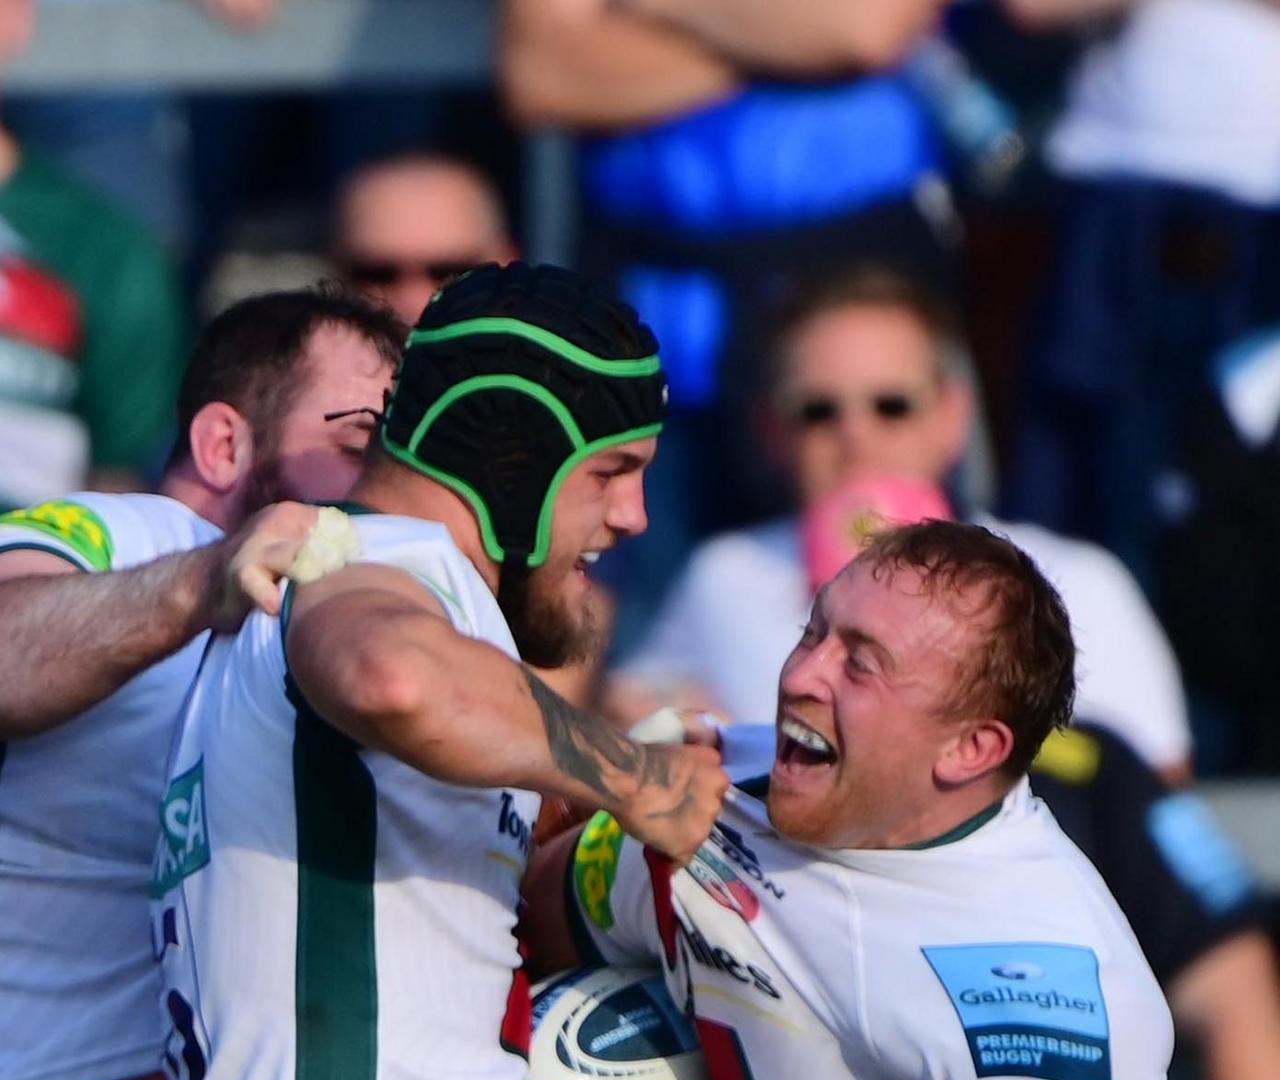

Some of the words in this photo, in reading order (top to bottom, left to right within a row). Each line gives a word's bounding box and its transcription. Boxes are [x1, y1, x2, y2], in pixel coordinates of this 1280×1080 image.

[959, 986, 1097, 1014] Gallagher
[975, 1033, 1104, 1064] PREMIERSHIP
[981, 1049, 1043, 1067] RUGBY
